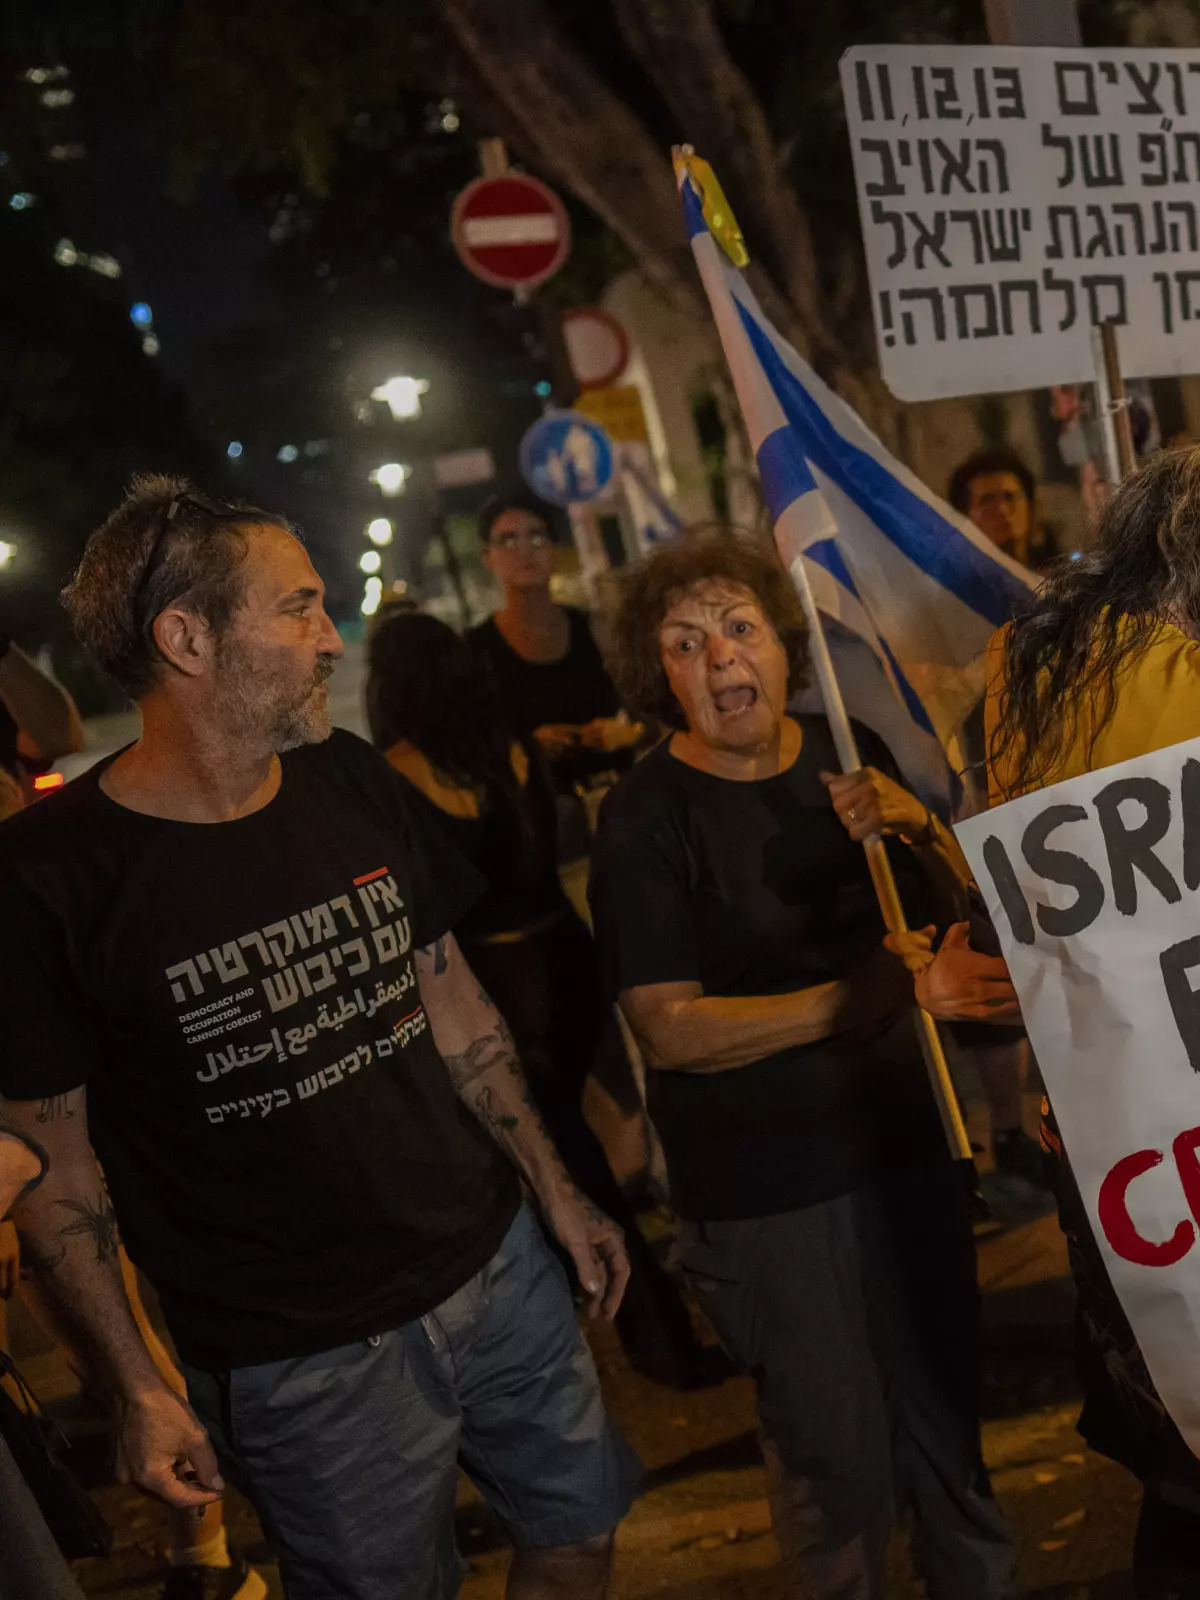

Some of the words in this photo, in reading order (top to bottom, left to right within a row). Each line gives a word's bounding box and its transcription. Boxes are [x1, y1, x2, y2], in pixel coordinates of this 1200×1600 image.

[860, 137, 1010, 196] האויב
[1041, 122, 1124, 188] של
[869, 200, 1031, 269] ישראל
[1045, 200, 1199, 259] הנהגת
[878, 267, 1129, 348] מלחמה!
[356, 875, 404, 928] אין
[165, 893, 360, 1003] דמוקרטיה
[371, 915, 412, 965] עם
[260, 936, 371, 1013] כיבוש
[178, 995, 234, 1023] DEMOCRACY
[235, 987, 255, 1002] AND
[182, 1005, 242, 1034] OCCUPATION
[186, 1025, 225, 1044] CANNOT
[225, 1010, 263, 1031] COEXIST
[196, 1027, 289, 1083] إحتلال
[284, 1022, 318, 1056] مع
[296, 1044, 373, 1100] לכיבוש
[205, 1087, 292, 1124] בעיניים
